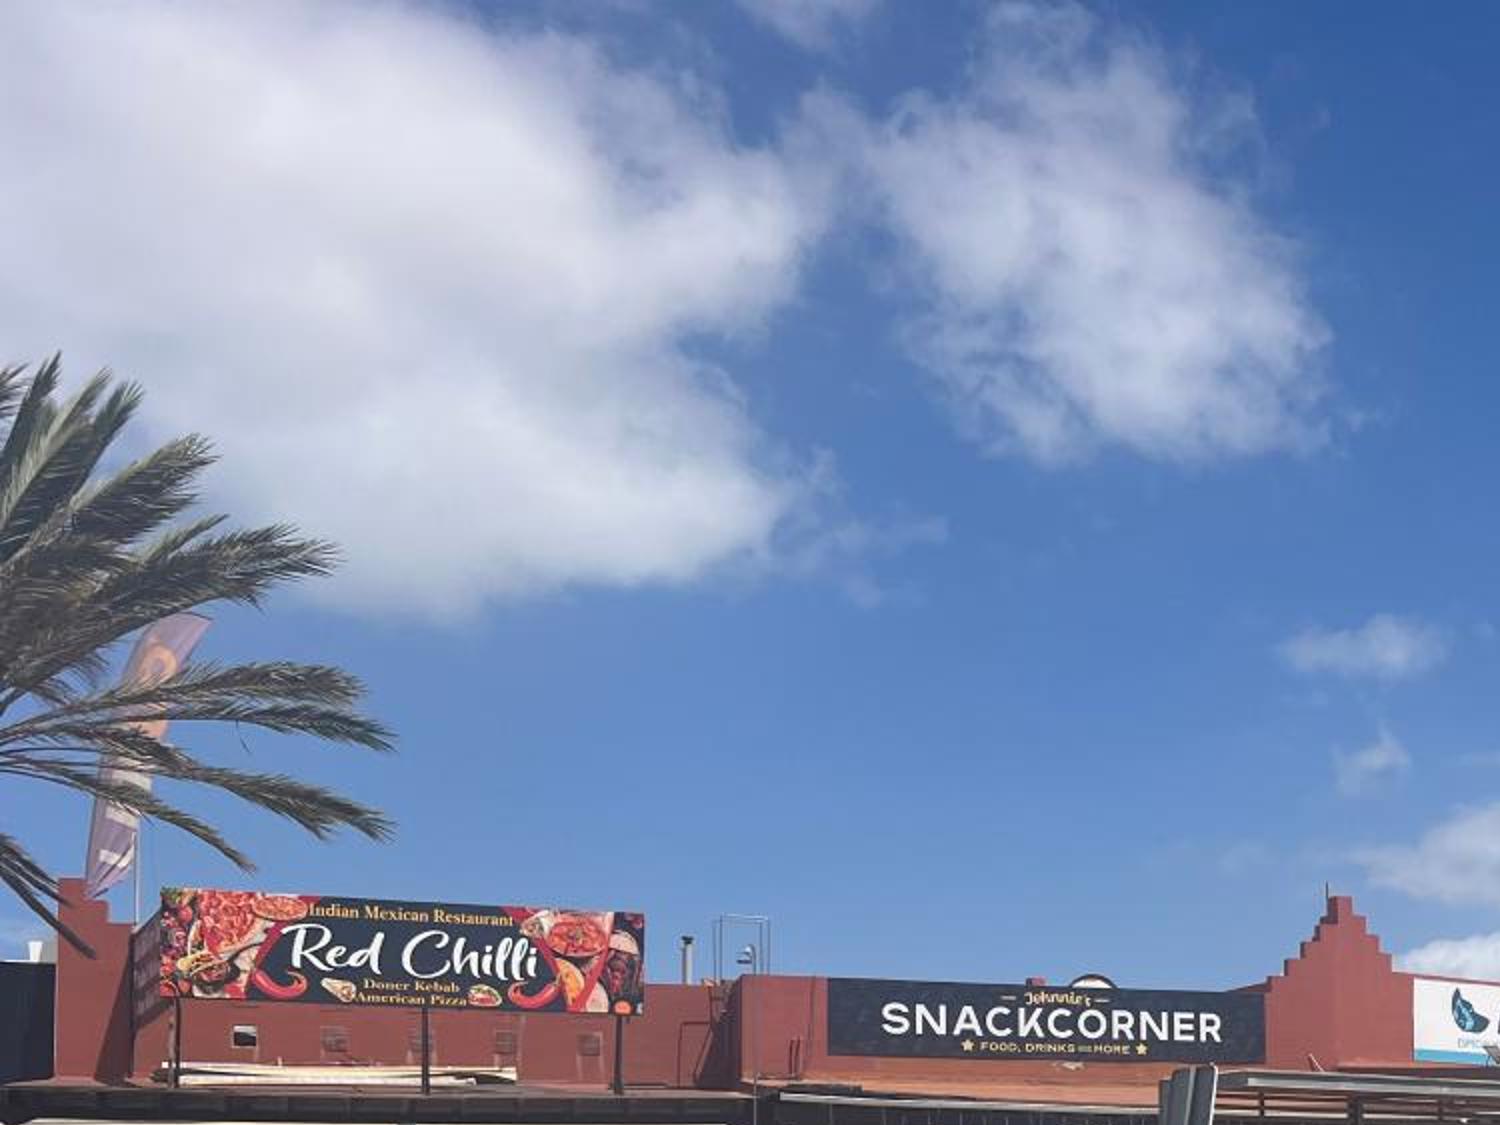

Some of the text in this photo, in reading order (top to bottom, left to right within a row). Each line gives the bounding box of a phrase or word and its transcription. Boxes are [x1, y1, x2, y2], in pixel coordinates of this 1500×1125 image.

[307, 903, 513, 927] Indian Mexican Restaurant
[281, 923, 538, 981] Red Chilli
[415, 980, 460, 993] Kebab
[355, 992, 467, 1007] American Pizza
[881, 1002, 1222, 1043] SNACKCORNER
[1025, 1043, 1075, 1054] DRINKS
[1093, 1045, 1130, 1055] MORE
